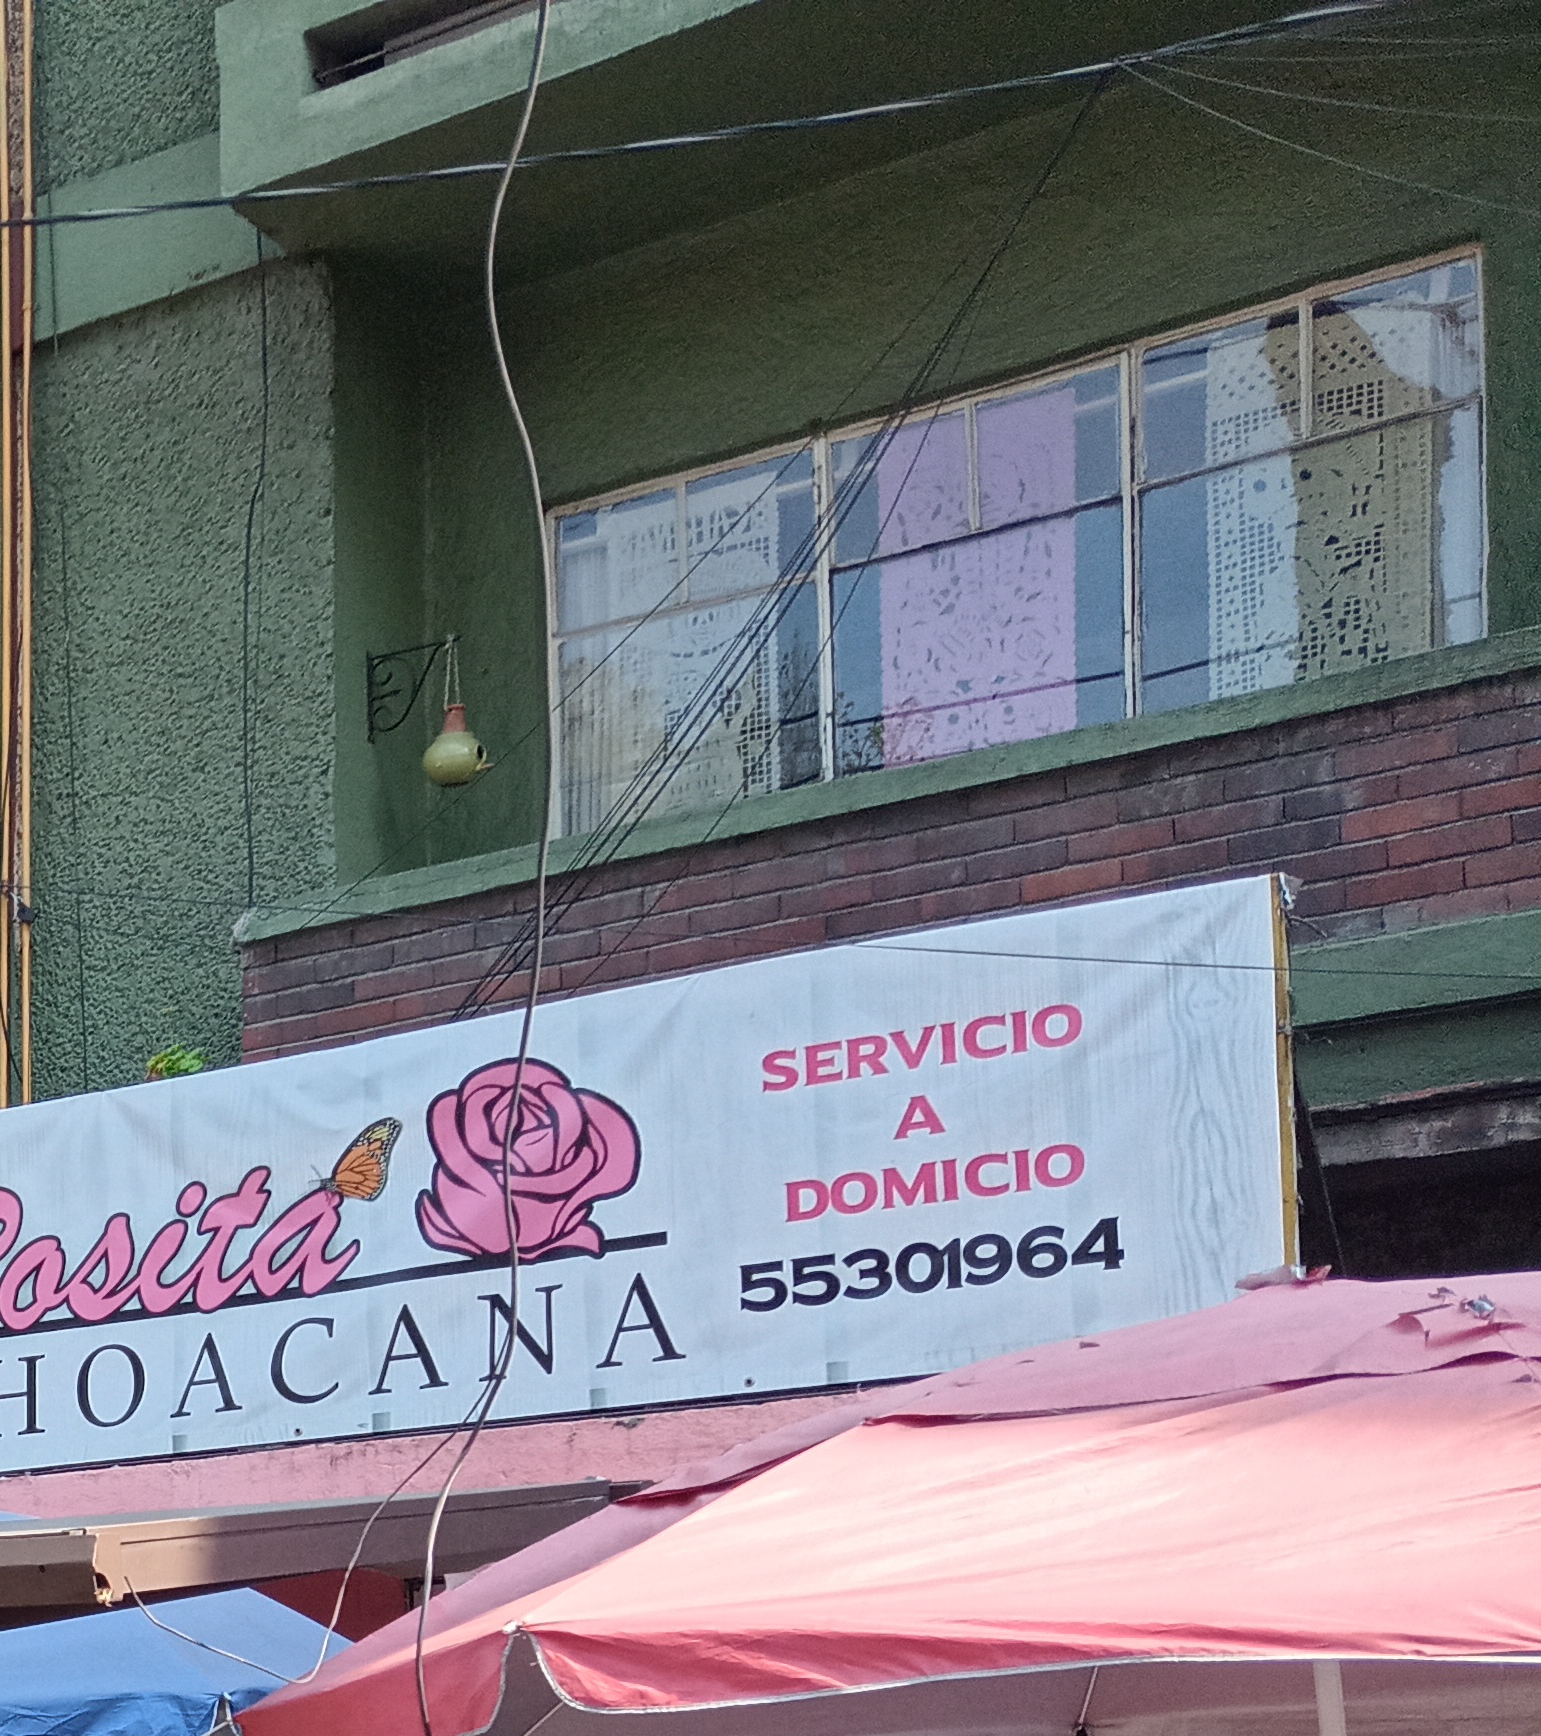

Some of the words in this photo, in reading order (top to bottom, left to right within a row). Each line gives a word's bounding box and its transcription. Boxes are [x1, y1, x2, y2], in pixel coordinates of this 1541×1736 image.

[761, 1002, 1084, 1094] SERVICIO
[893, 1095, 947, 1141] A
[784, 1143, 1087, 1225] DOMICIO
[738, 1217, 1125, 1314] 55301964
